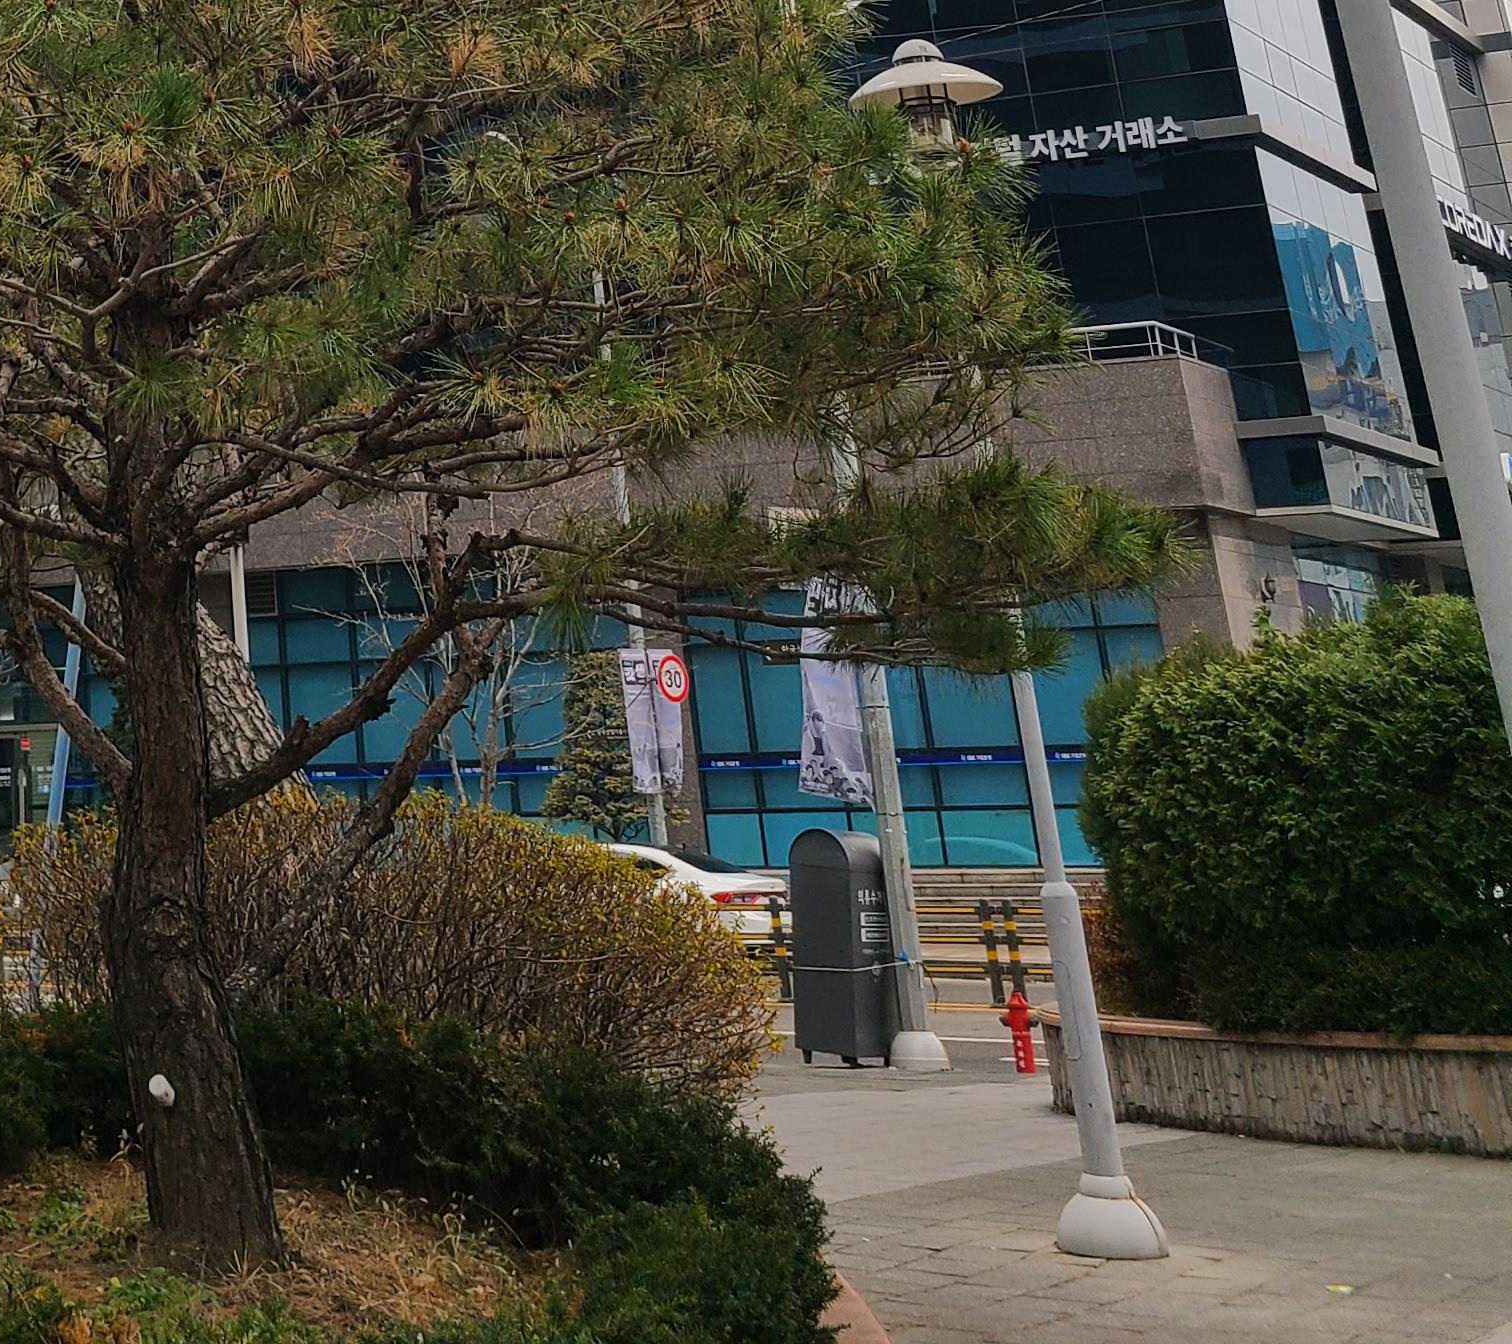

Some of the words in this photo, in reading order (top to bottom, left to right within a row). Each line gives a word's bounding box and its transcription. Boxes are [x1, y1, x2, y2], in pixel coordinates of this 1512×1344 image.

[1029, 125, 1089, 161] 자산
[1095, 115, 1188, 153] 거래소
[665, 670, 682, 688] 30
